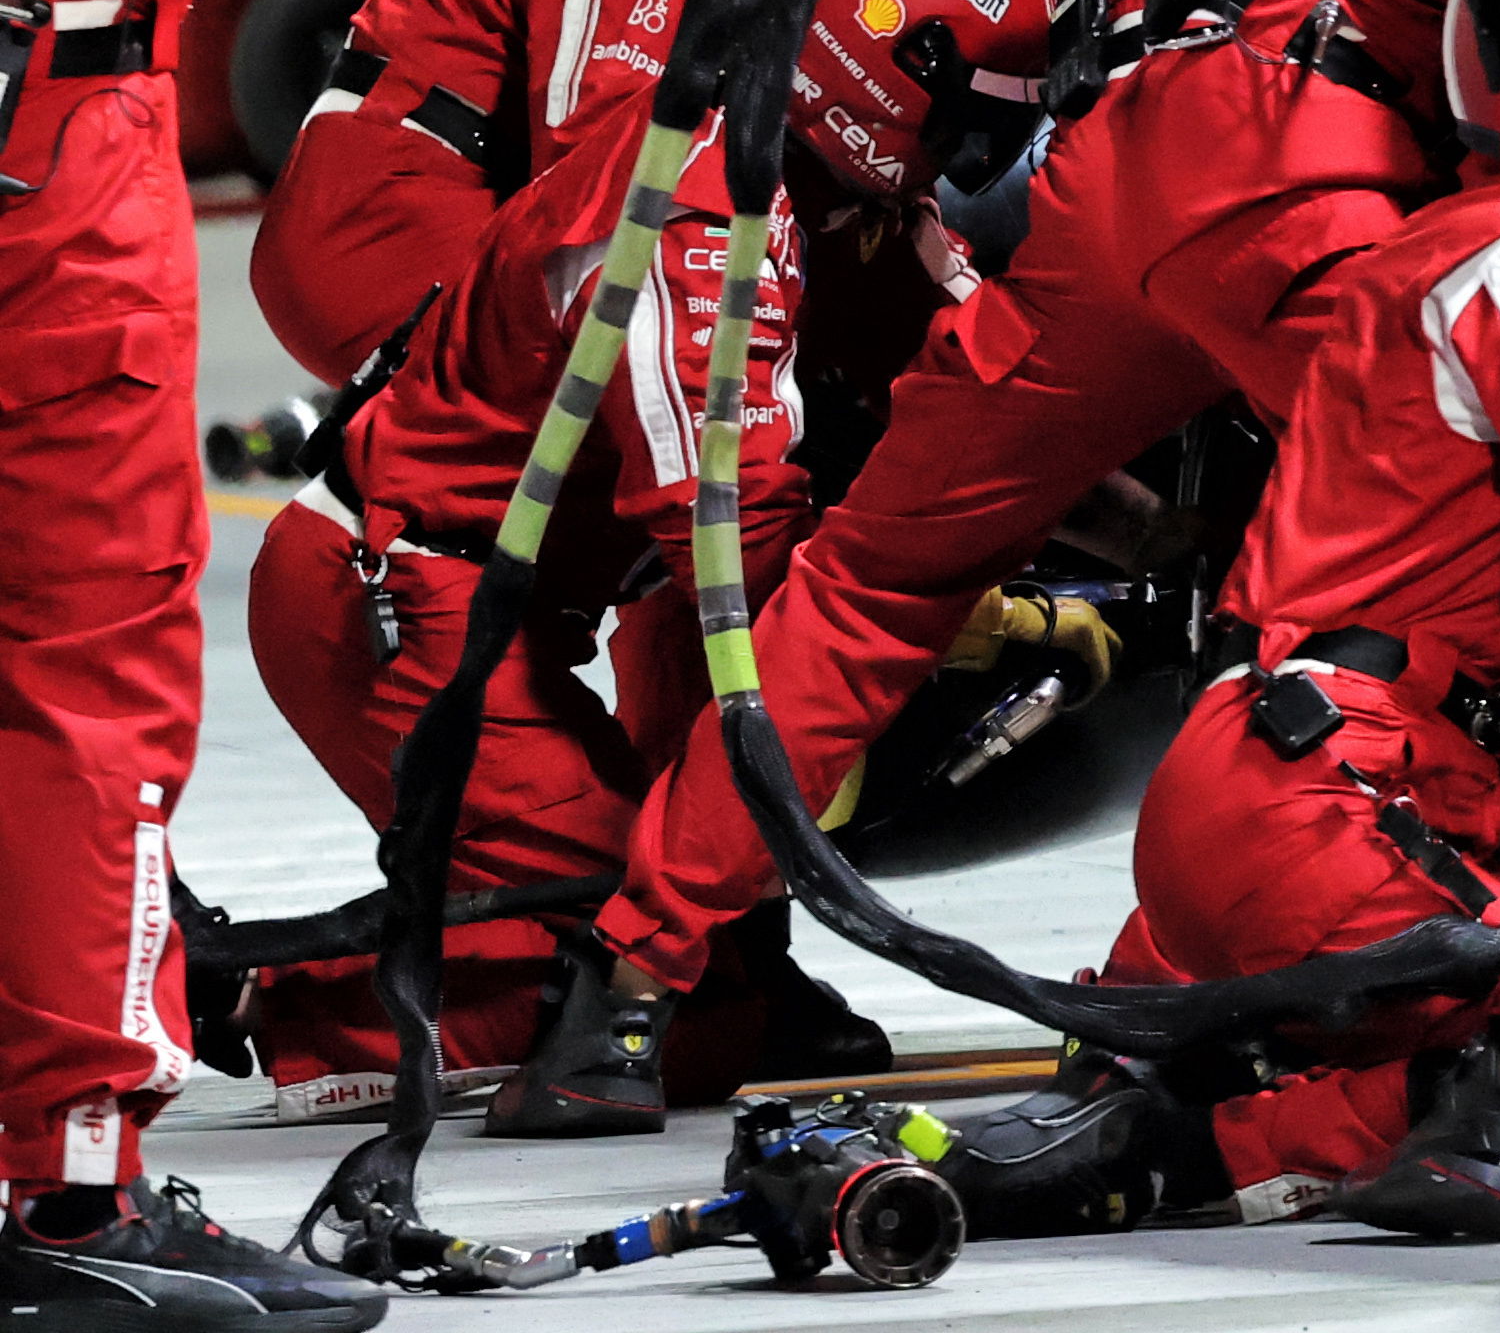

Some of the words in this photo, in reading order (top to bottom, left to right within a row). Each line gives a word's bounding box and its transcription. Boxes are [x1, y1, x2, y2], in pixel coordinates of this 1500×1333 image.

[812, 20, 866, 81] RICHARD
[863, 75, 904, 117] MILLE
[824, 105, 905, 184] CEVA
[126, 851, 163, 1040] SCUDERIA
[315, 1083, 360, 1106] HP
